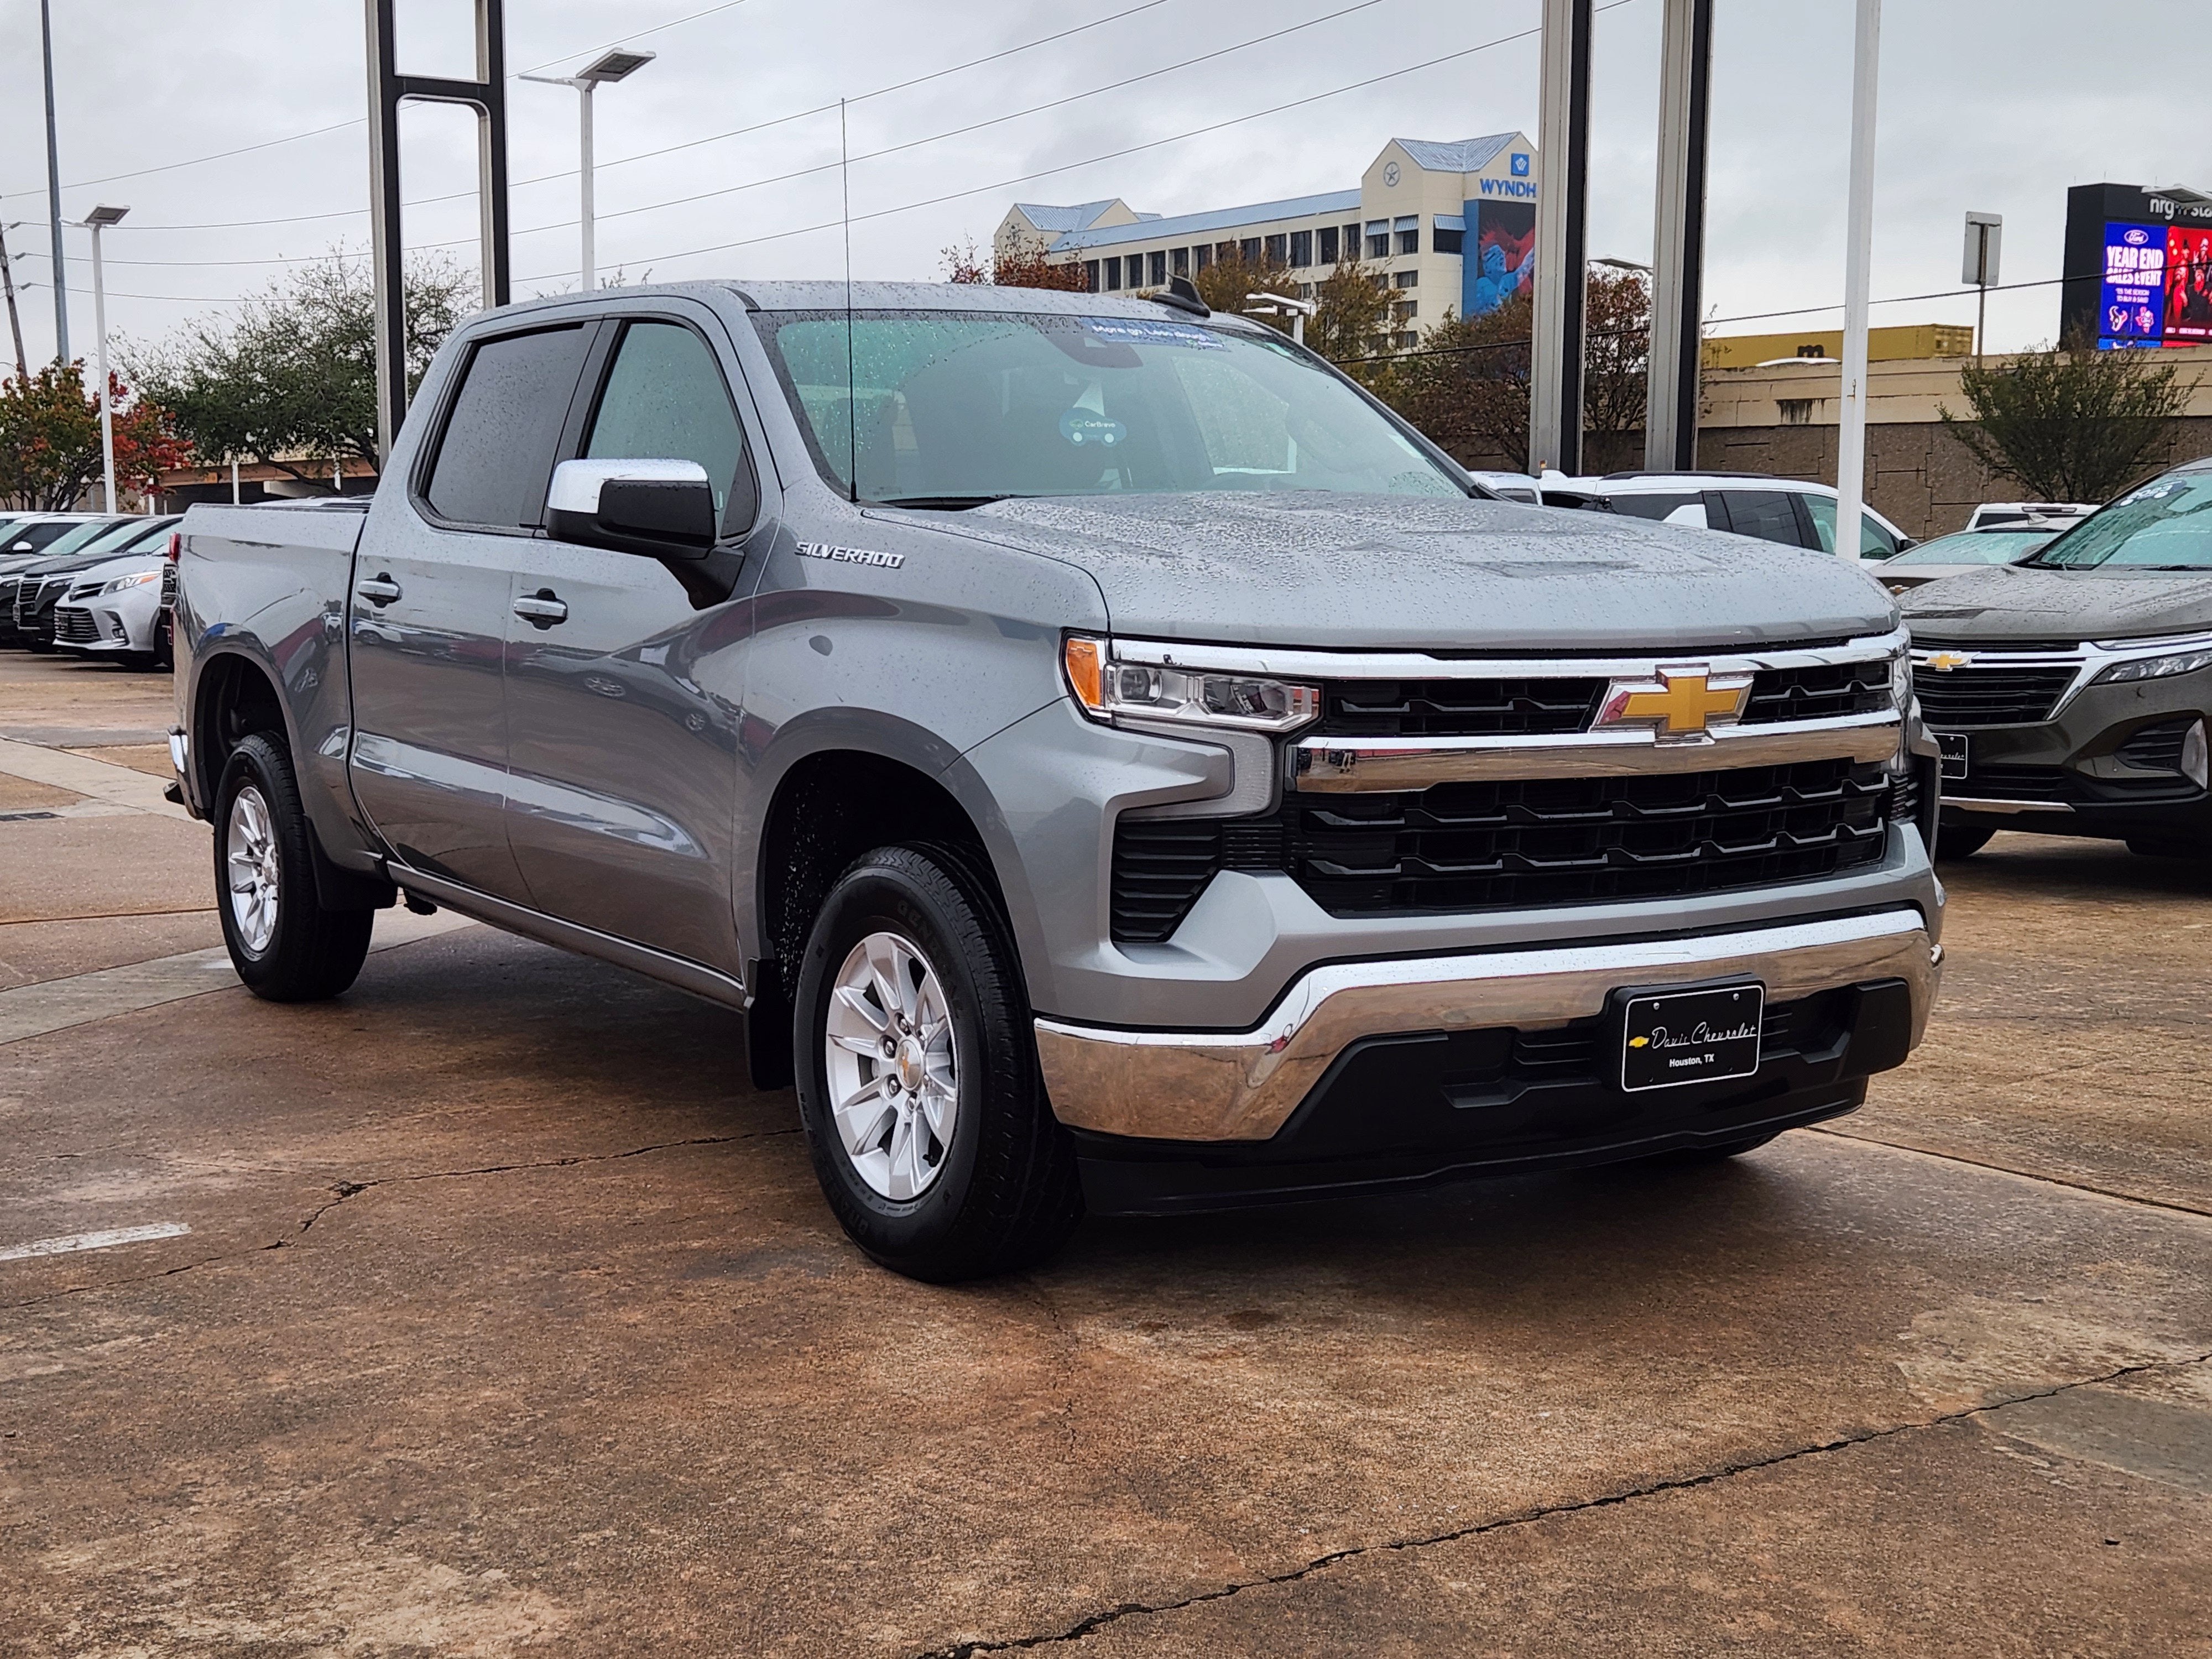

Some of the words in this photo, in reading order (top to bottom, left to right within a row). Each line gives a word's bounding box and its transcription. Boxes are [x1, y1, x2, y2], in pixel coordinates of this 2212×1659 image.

[1480, 178, 1537, 198] WYNDH
[2150, 198, 2174, 220] nrg
[2106, 246, 2138, 268] YEAR
[2139, 248, 2164, 269] END
[2106, 267, 2134, 284] SALES
[2134, 270, 2163, 286] EVENT
[795, 541, 906, 569] SILVERADO
[1652, 1026, 1690, 1049] Davis
[1691, 1021, 1757, 1042] Chevrolet
[1669, 1057, 1703, 1068] Houston,
[1704, 1053, 1714, 1063] TX
